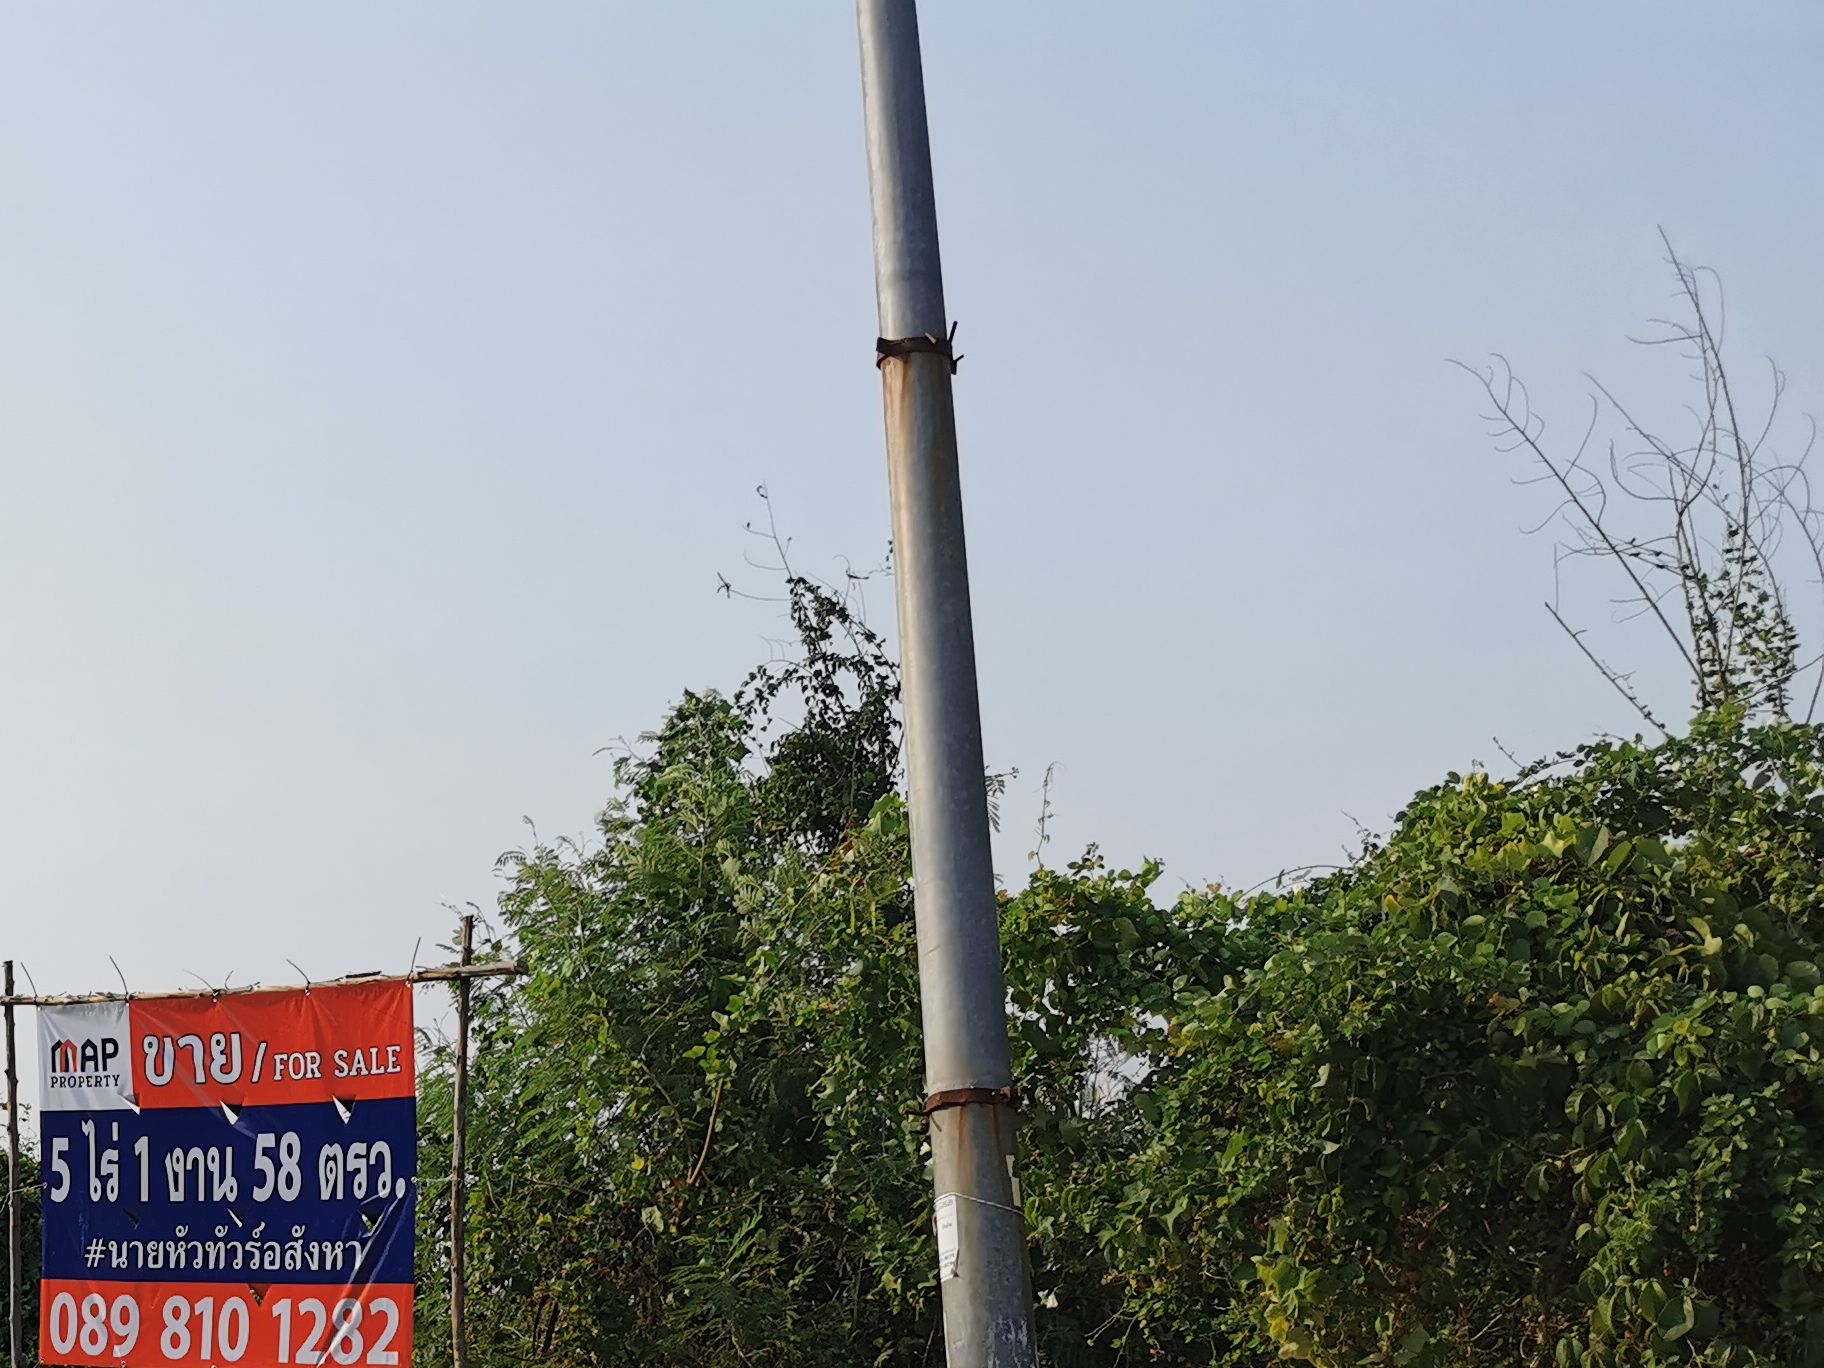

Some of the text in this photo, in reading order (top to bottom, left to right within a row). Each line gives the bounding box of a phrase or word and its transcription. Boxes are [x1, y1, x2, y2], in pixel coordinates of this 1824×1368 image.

[50, 1037, 120, 1074] MAP
[50, 1074, 120, 1089] PROPERTY
[142, 1031, 243, 1087] ขาย
[273, 1052, 322, 1081] FOR
[333, 1045, 401, 1079] SALE
[50, 1119, 406, 1203] 5 ไร่ 1 งาน 58 ตรว.
[49, 1291, 400, 1366] 089 810 1282
